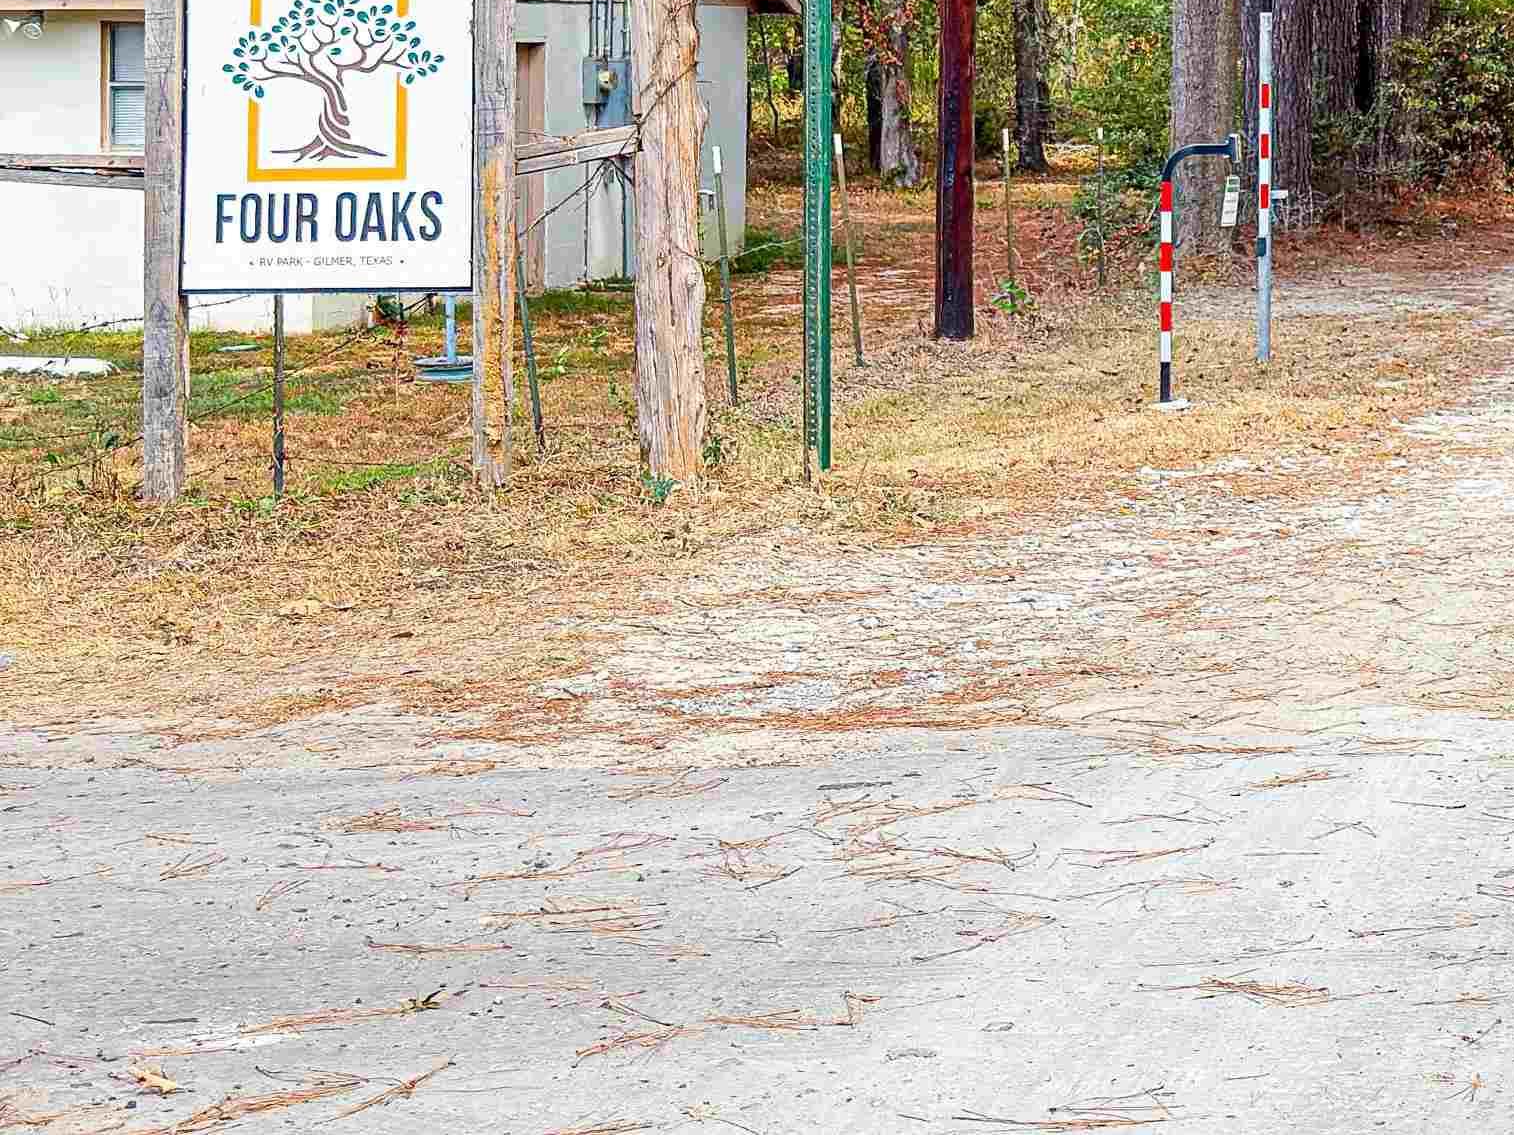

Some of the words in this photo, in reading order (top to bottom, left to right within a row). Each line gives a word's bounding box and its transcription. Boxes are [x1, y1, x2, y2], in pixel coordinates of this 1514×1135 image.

[215, 192, 319, 243] FOUR
[334, 190, 442, 242] OAKS
[259, 256, 274, 266] RV
[277, 256, 303, 266] PARK
[313, 255, 356, 267] GILMER,
[359, 255, 392, 266] TEXAS
